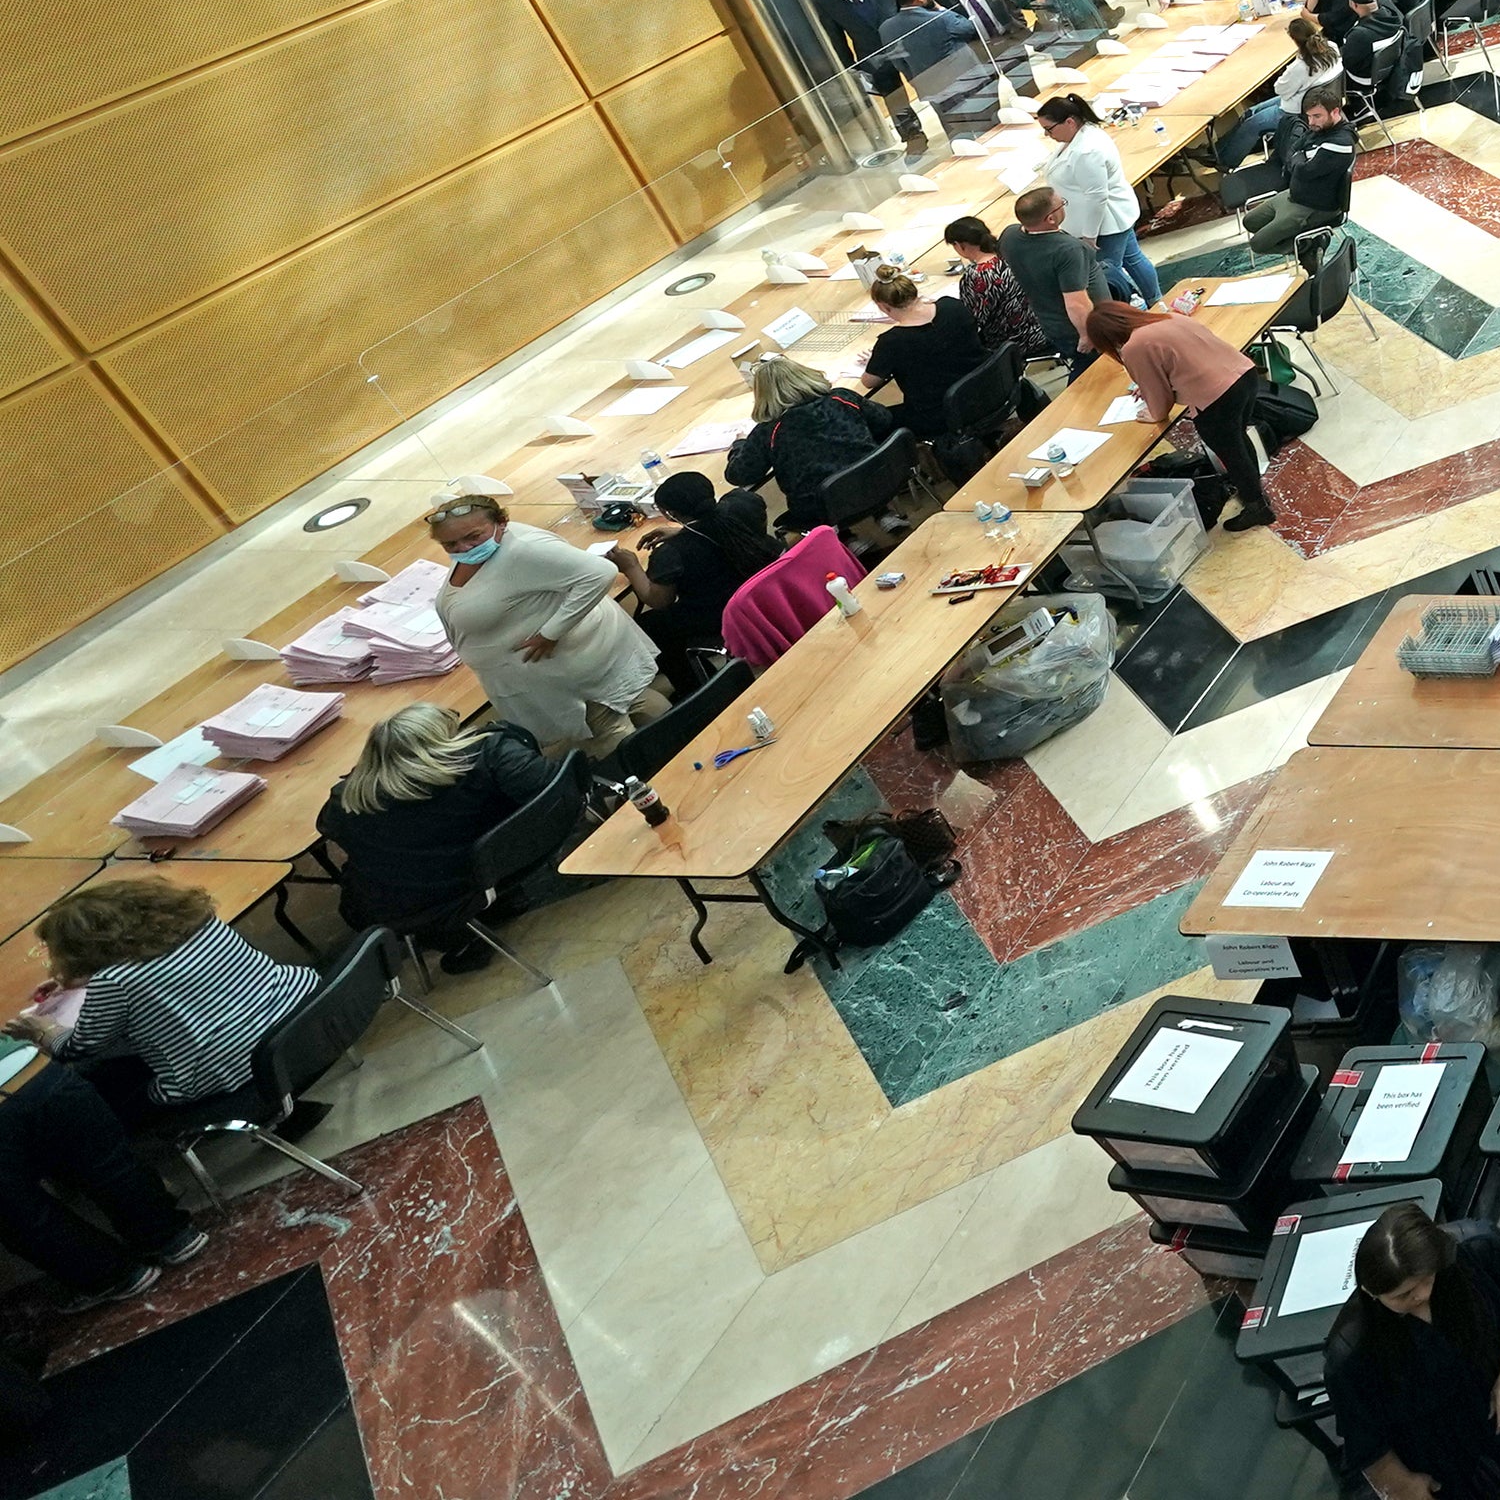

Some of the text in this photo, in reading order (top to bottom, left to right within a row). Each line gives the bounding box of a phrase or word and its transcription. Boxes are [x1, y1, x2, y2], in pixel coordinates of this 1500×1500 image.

[1144, 1044, 1181, 1087] This box has
[1152, 1044, 1190, 1091] been verified
[1394, 1101, 1420, 1109] verified
